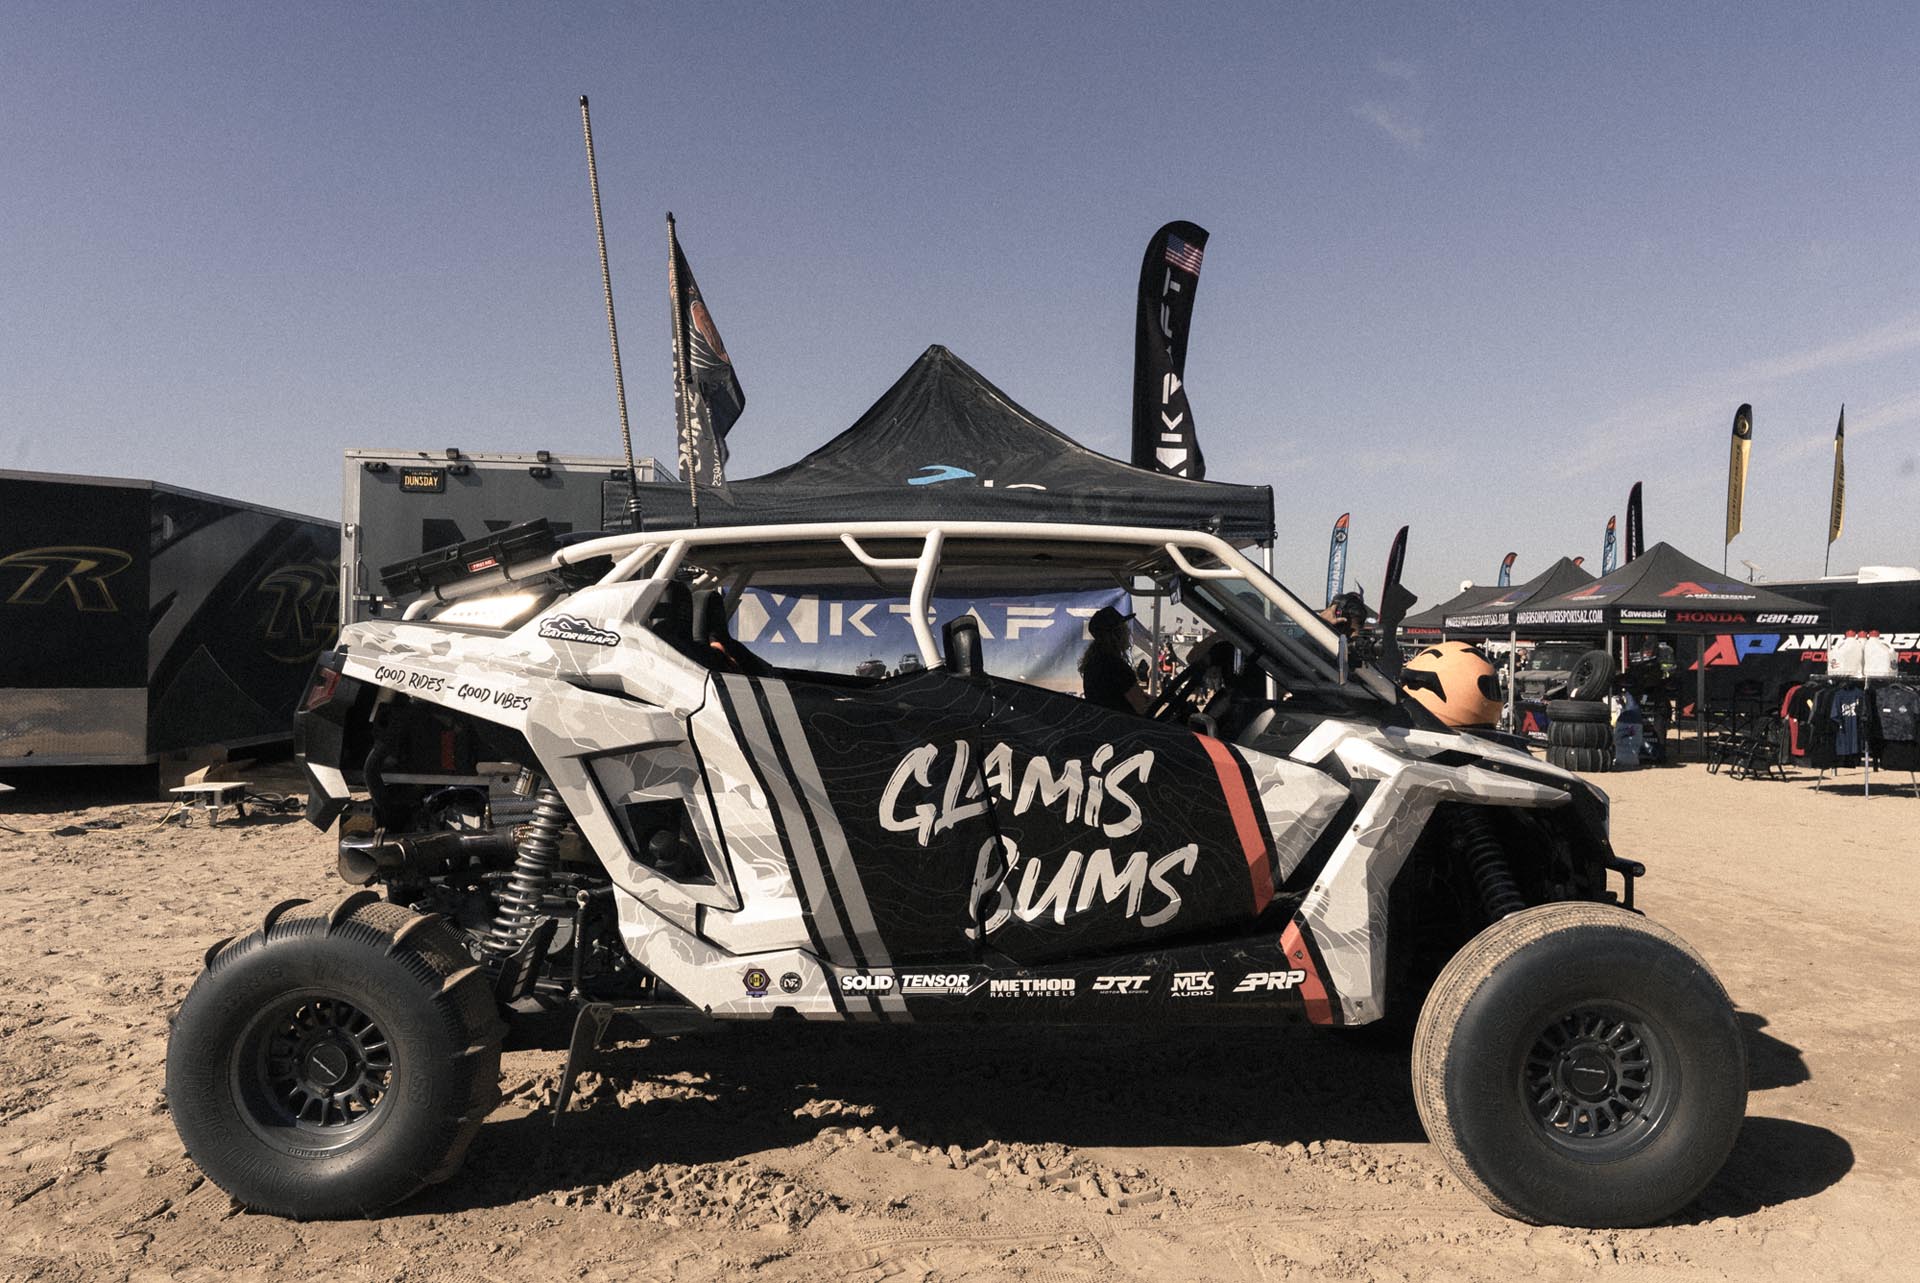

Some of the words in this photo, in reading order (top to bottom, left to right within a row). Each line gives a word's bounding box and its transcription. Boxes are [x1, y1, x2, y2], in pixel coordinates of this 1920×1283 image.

[404, 475, 439, 487] DUNSDAY
[1620, 609, 1667, 618] Kawasaki
[1677, 612, 1746, 622] HONDA
[1756, 613, 1820, 625] can-am
[541, 629, 618, 646] GATORWRAPS
[375, 665, 406, 684] GOOD
[408, 672, 445, 692] RIDES
[457, 683, 491, 702] GOOD
[493, 692, 532, 711] VIBES
[964, 833, 1199, 940] BUMS
[841, 975, 894, 991] SOLID
[901, 974, 971, 987] TENSOR
[990, 978, 1076, 992] METHOD
[1092, 975, 1151, 994] DRT
[1170, 971, 1215, 992] MTX
[1233, 970, 1306, 993] PRP
[947, 986, 969, 994] TIRE
